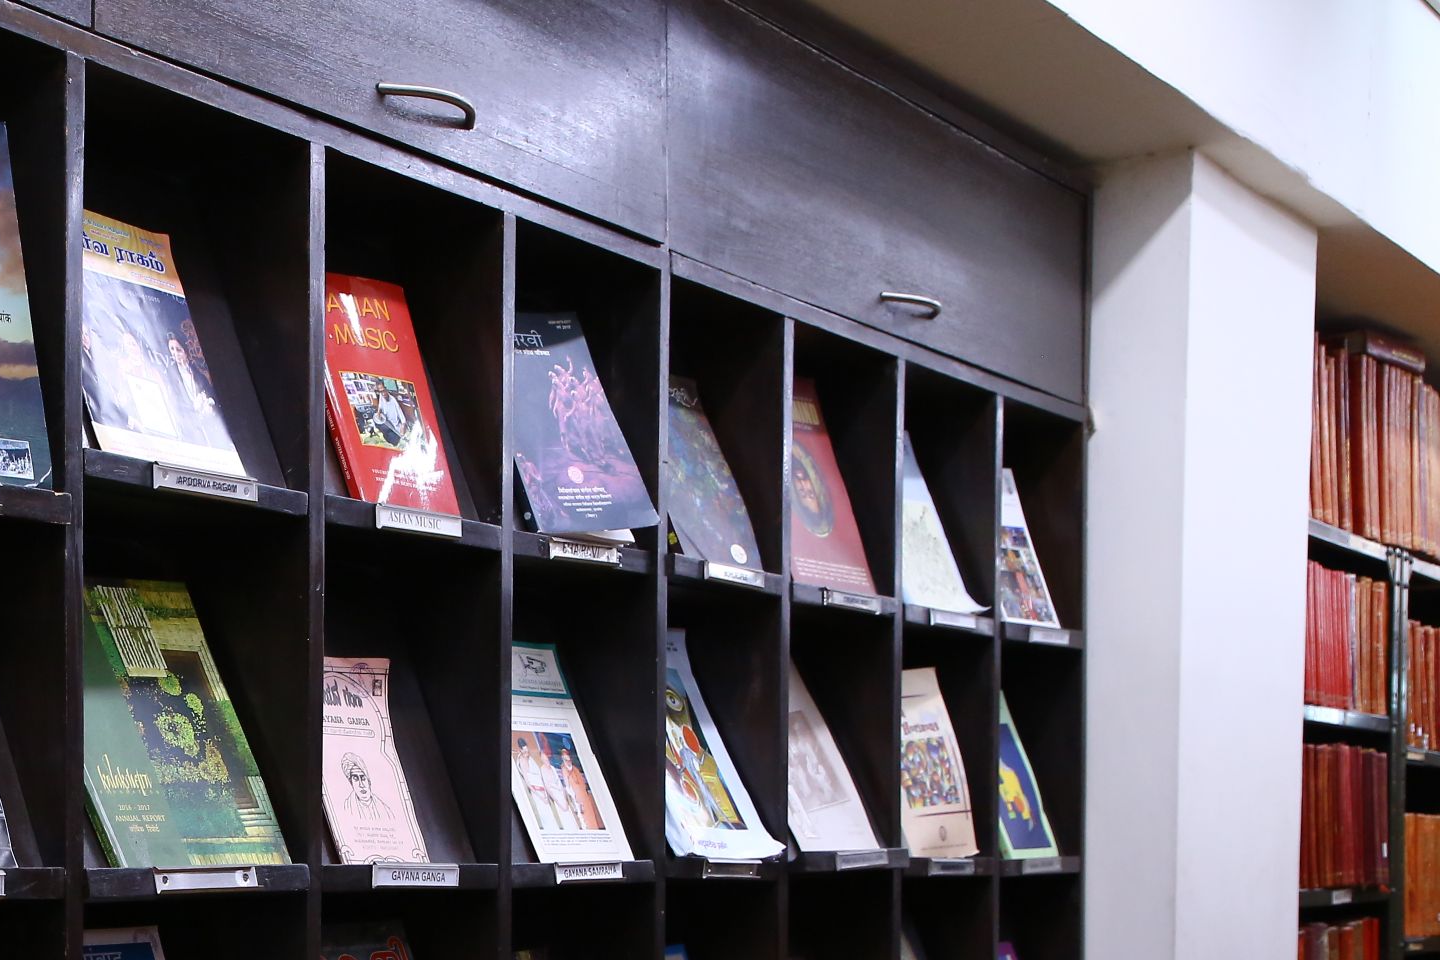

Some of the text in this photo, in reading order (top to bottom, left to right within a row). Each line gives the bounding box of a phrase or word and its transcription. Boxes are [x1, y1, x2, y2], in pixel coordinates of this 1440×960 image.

[326, 291, 391, 322] AIAN
[388, 511, 442, 530] ASIAN MUSIC
[115, 814, 166, 823] ANNUAL REPORT
[391, 870, 446, 883] GAYANA GANGA
[563, 866, 589, 879] GAYANA
